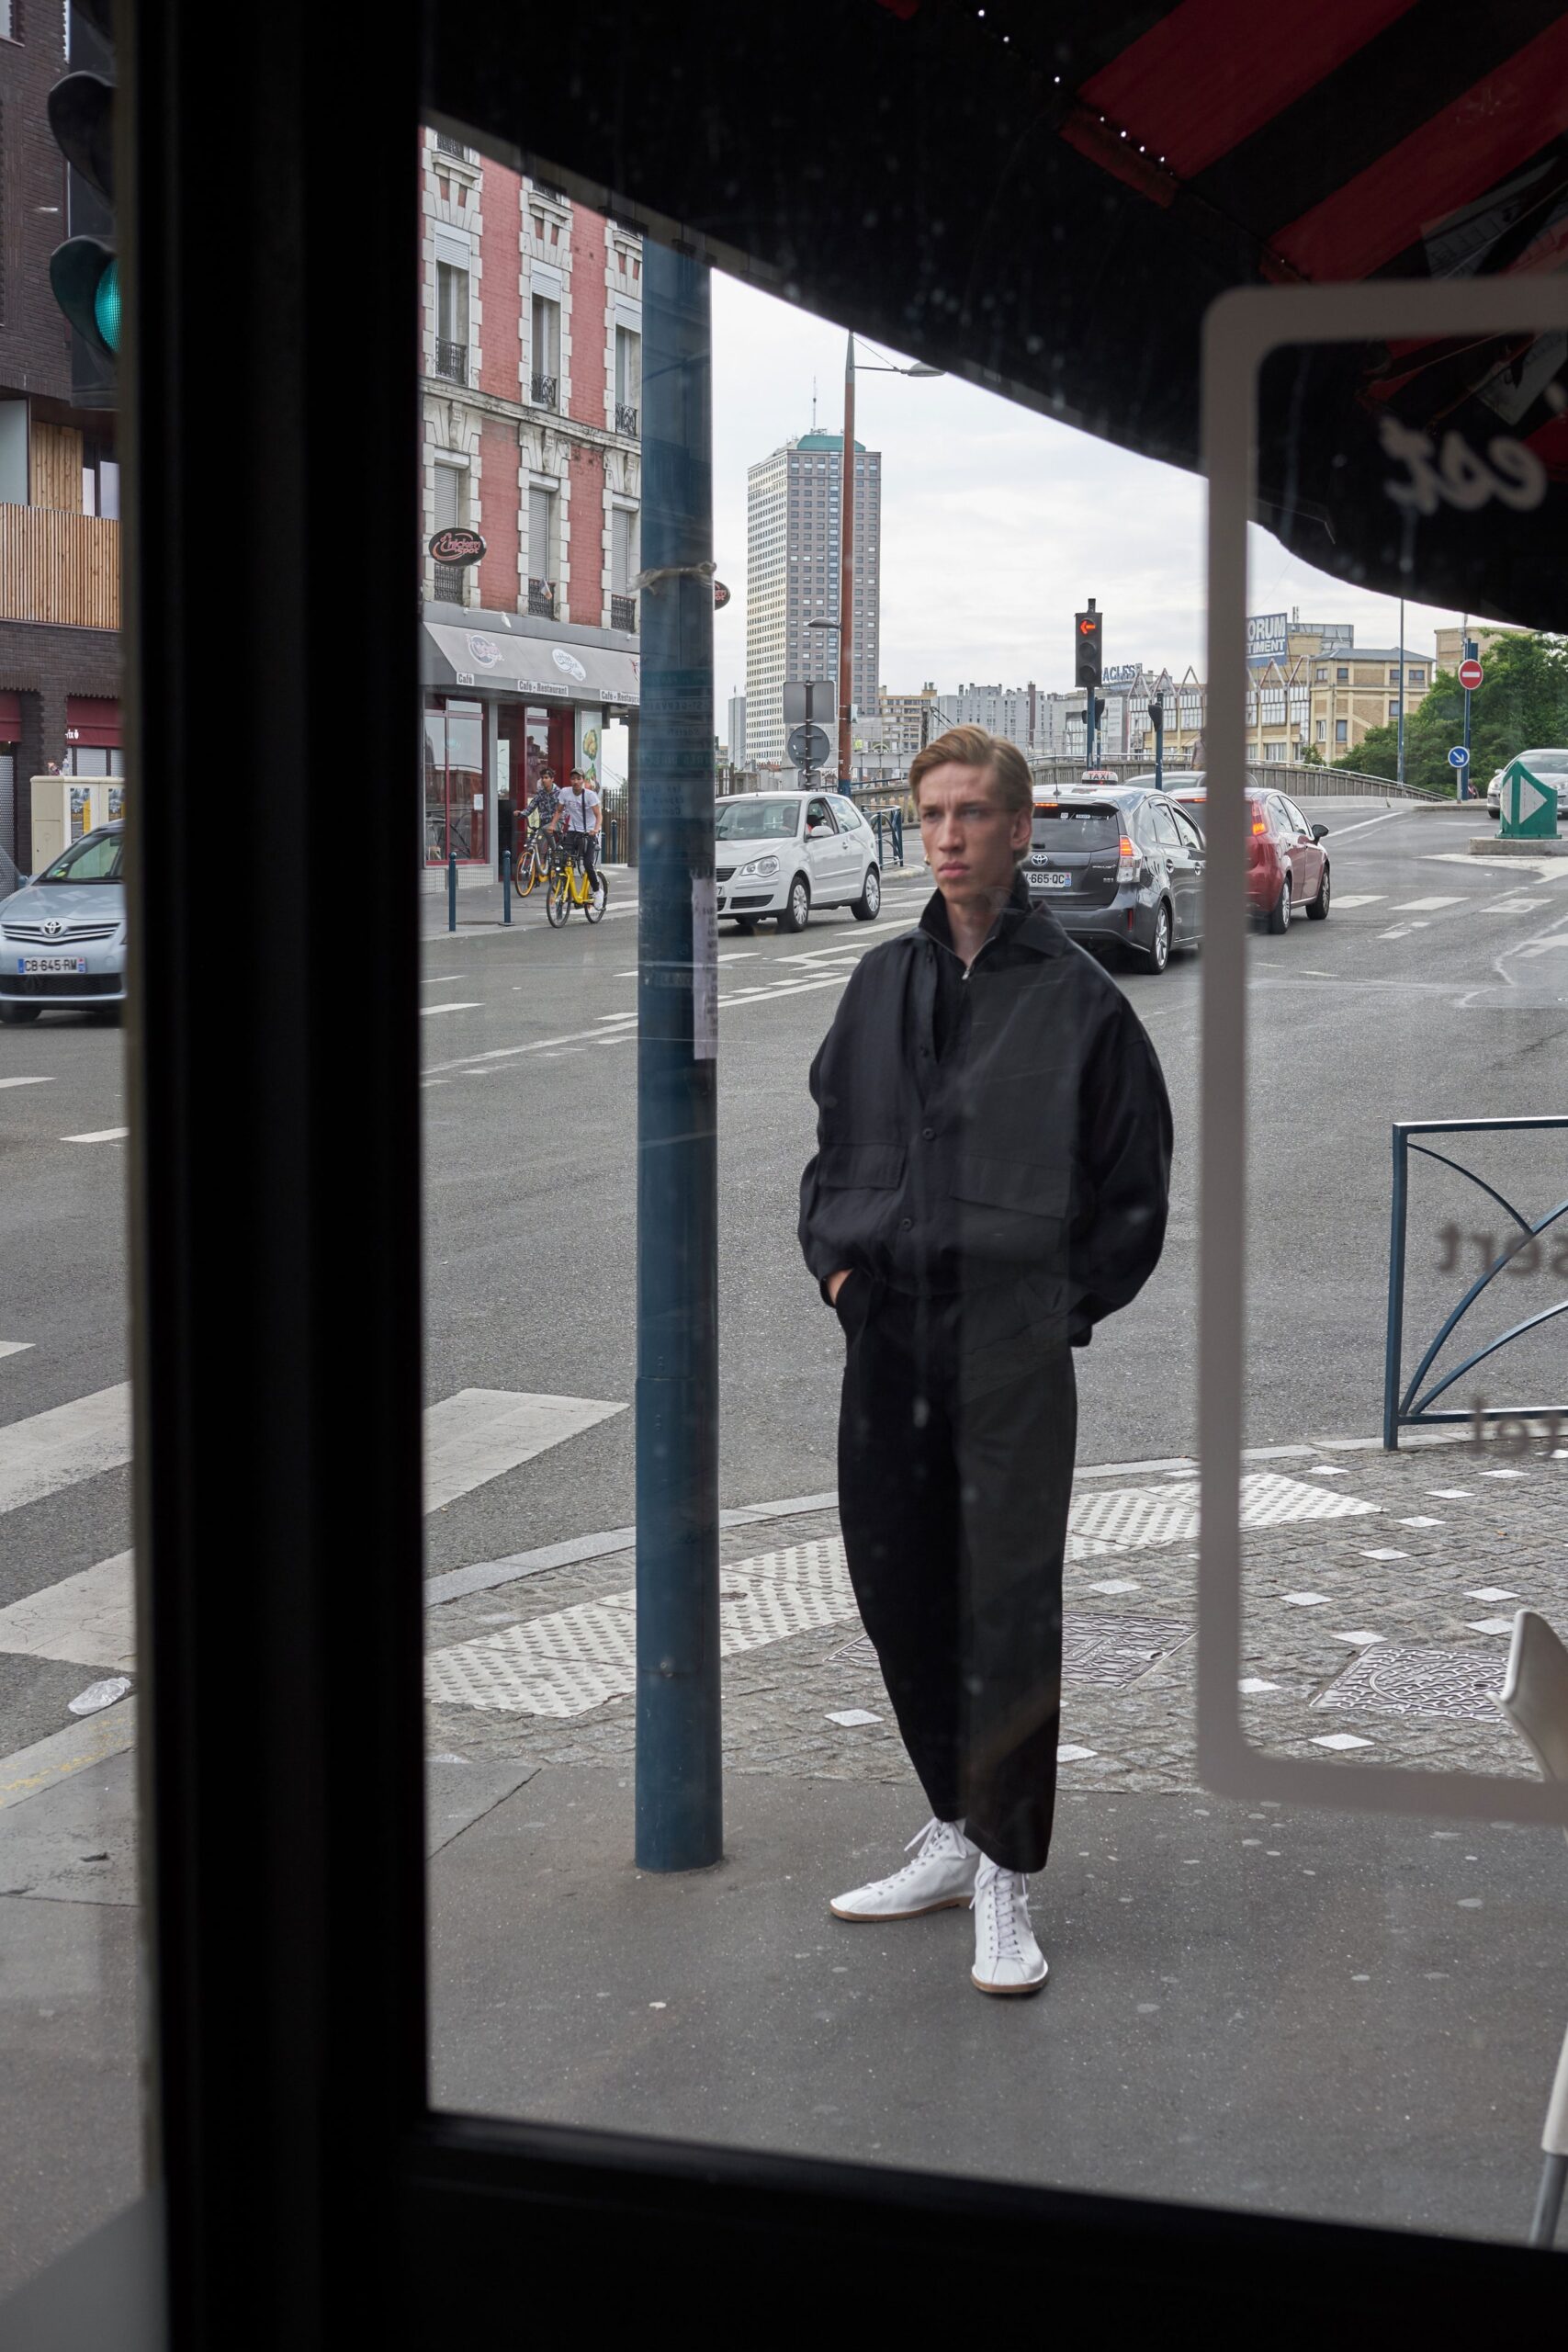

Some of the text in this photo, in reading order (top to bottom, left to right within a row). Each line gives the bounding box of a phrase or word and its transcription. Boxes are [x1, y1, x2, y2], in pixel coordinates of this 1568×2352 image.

[1248, 616, 1286, 641] ORUM
[1247, 639, 1286, 654] TIMENT
[1102, 665, 1135, 682] ACLES
